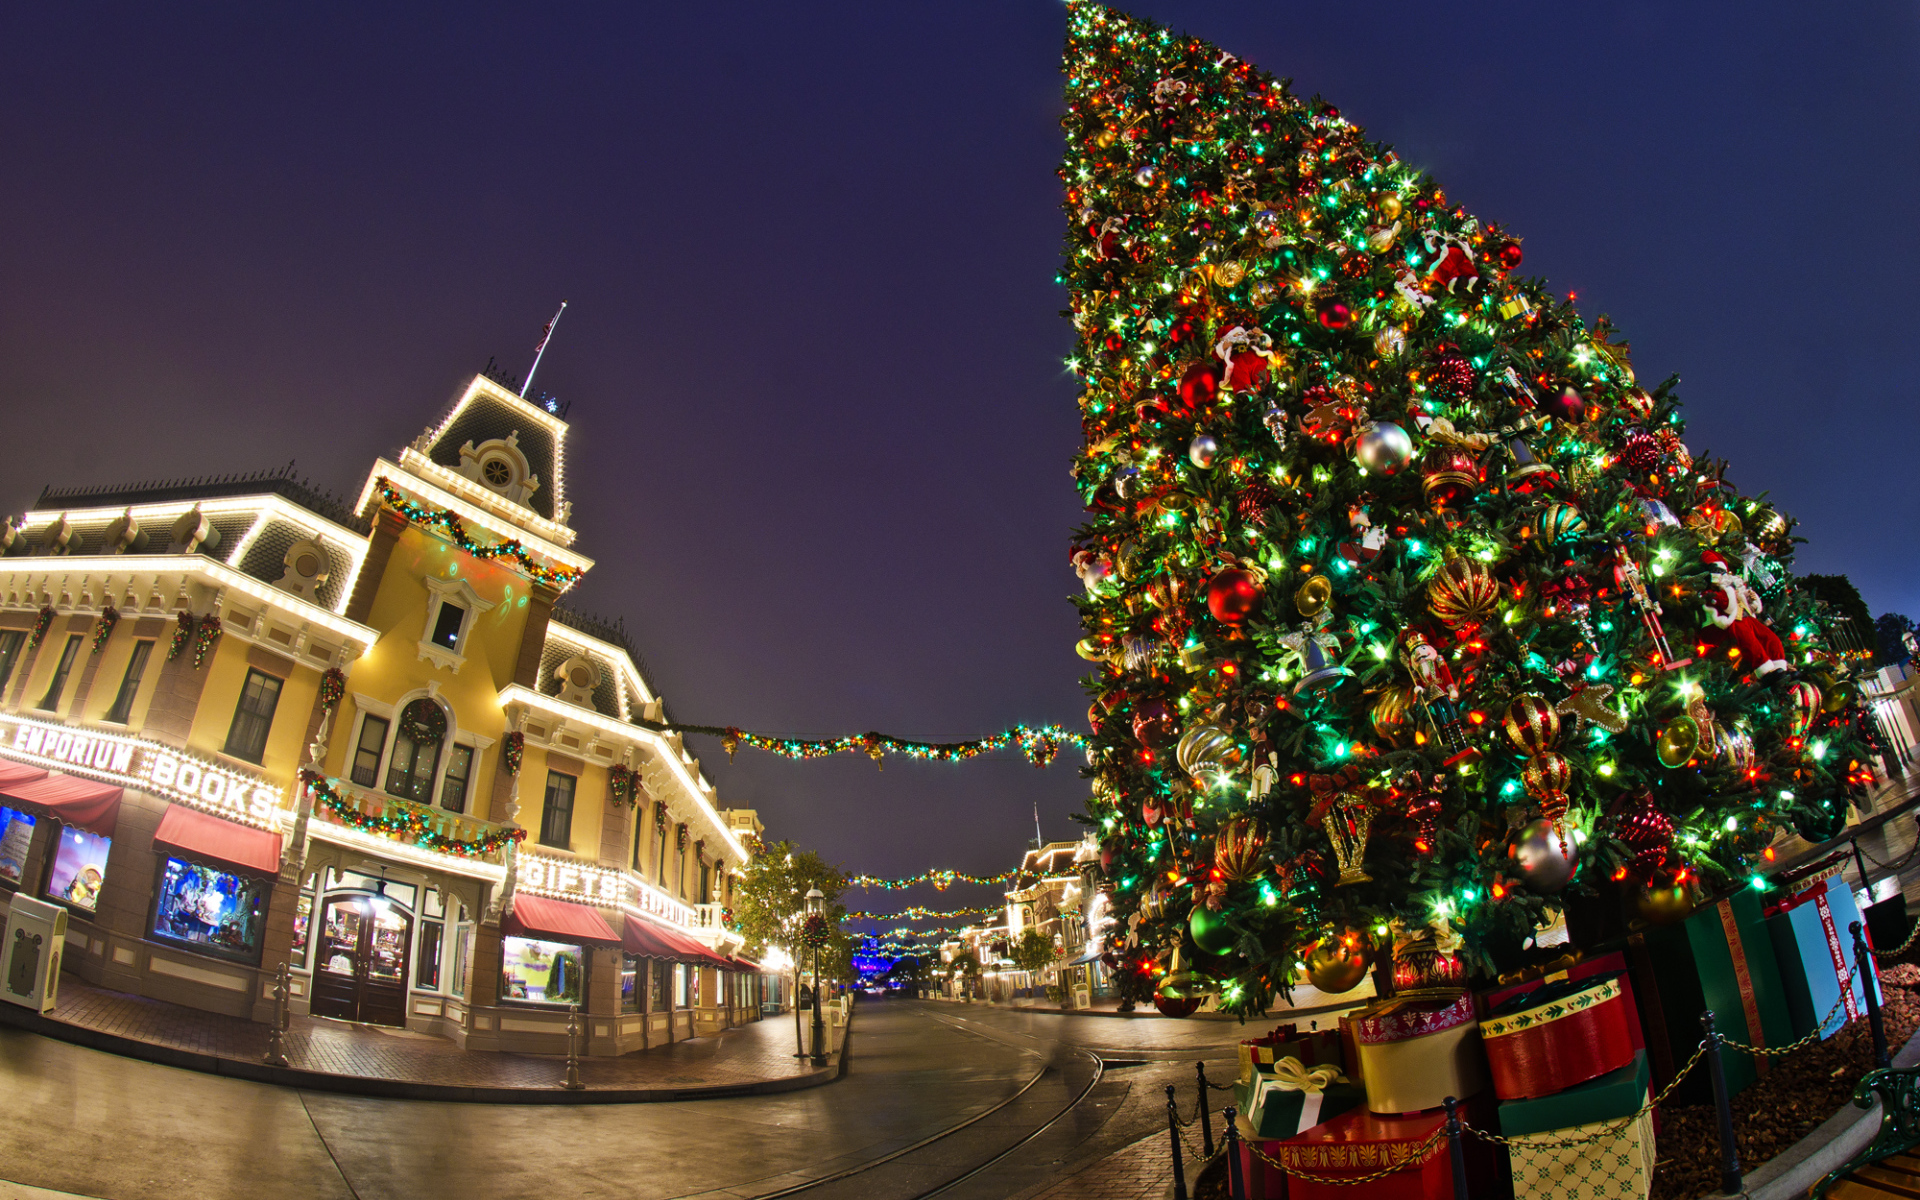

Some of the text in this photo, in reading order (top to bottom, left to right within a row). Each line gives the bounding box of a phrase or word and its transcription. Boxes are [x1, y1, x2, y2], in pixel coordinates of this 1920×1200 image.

[13, 724, 134, 773] EMPORIUM
[151, 753, 275, 819] BOOKS
[525, 861, 618, 900] GIFTS
